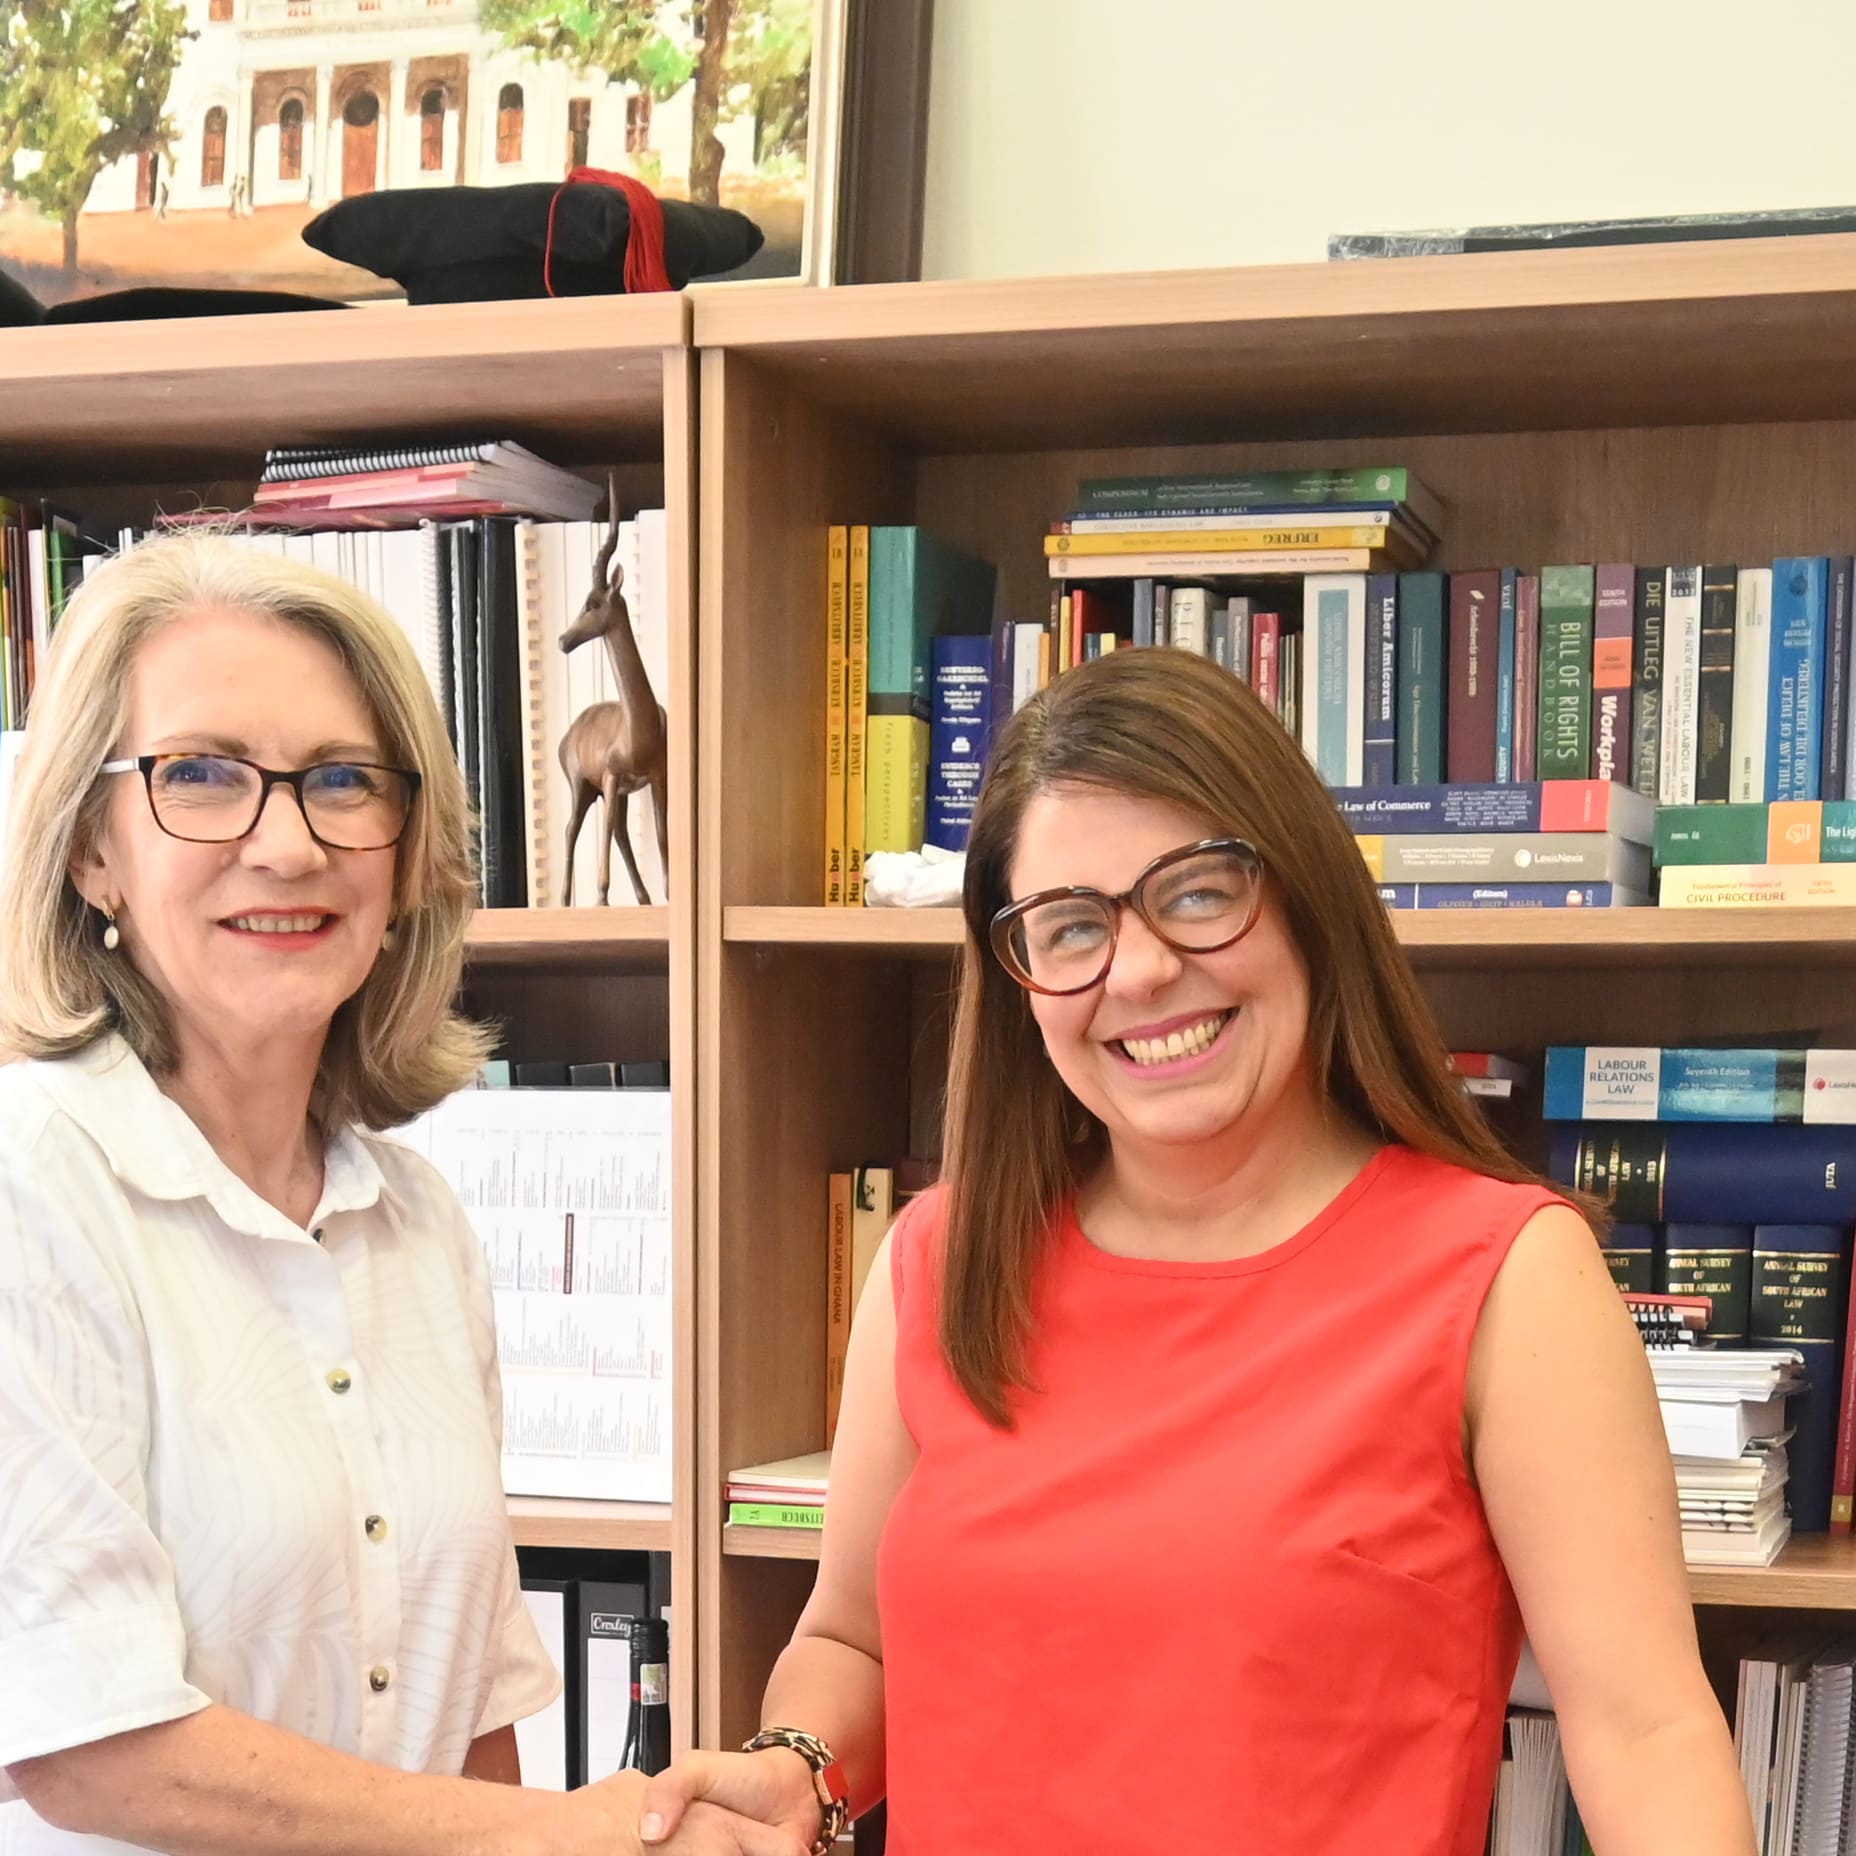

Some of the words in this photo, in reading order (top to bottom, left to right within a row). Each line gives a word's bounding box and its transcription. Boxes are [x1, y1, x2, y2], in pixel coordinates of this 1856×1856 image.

[1382, 596, 1394, 638] Liber
[1684, 617, 1694, 637] THE
[1559, 622, 1581, 659] BILL
[1683, 640, 1693, 664] NEW
[1381, 641, 1393, 721] Amicorum
[1559, 665, 1580, 687] OF
[1542, 623, 1557, 759] HANDBOOK
[1681, 668, 1692, 726] ESSENTIAL
[1556, 696, 1578, 759] RIGHTS
[1680, 728, 1691, 772] LABOUR
[1679, 775, 1689, 798] LAW
[1825, 824, 1842, 836] The
[829, 848, 840, 902] Hueber
[1686, 892, 1712, 904] CIVIL
[1715, 891, 1787, 903] PROCEDURE
[1597, 1059, 1648, 1071] LABOUR
[1589, 1071, 1655, 1083] RELATIONS
[1607, 1083, 1635, 1095] LAW
[1824, 1162, 1837, 1189] JUTA
[1789, 1274, 1801, 1284] OF
[1791, 1287, 1827, 1297] AFRICAN
[1783, 1299, 1803, 1309] LAW
